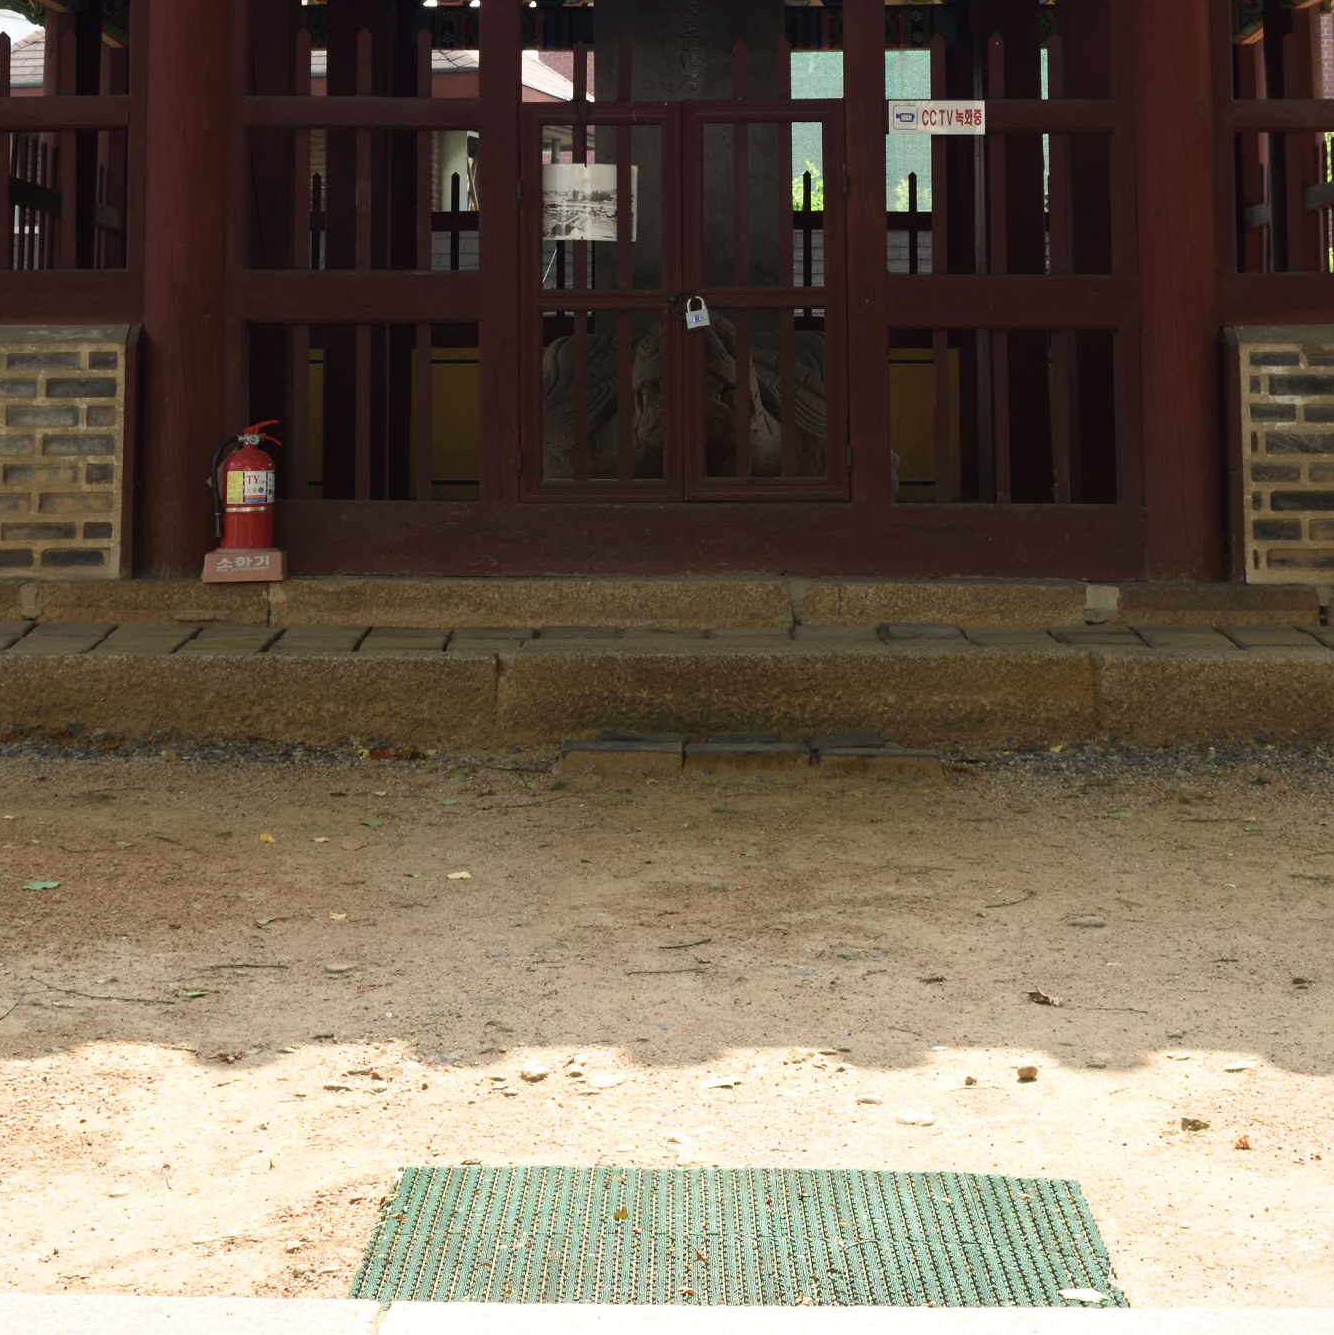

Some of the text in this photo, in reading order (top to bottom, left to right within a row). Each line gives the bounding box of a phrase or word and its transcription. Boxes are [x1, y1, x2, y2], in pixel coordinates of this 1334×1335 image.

[922, 109, 982, 126] CCTV 녹화중
[246, 475, 260, 484] TY
[217, 555, 270, 569] 소화기
